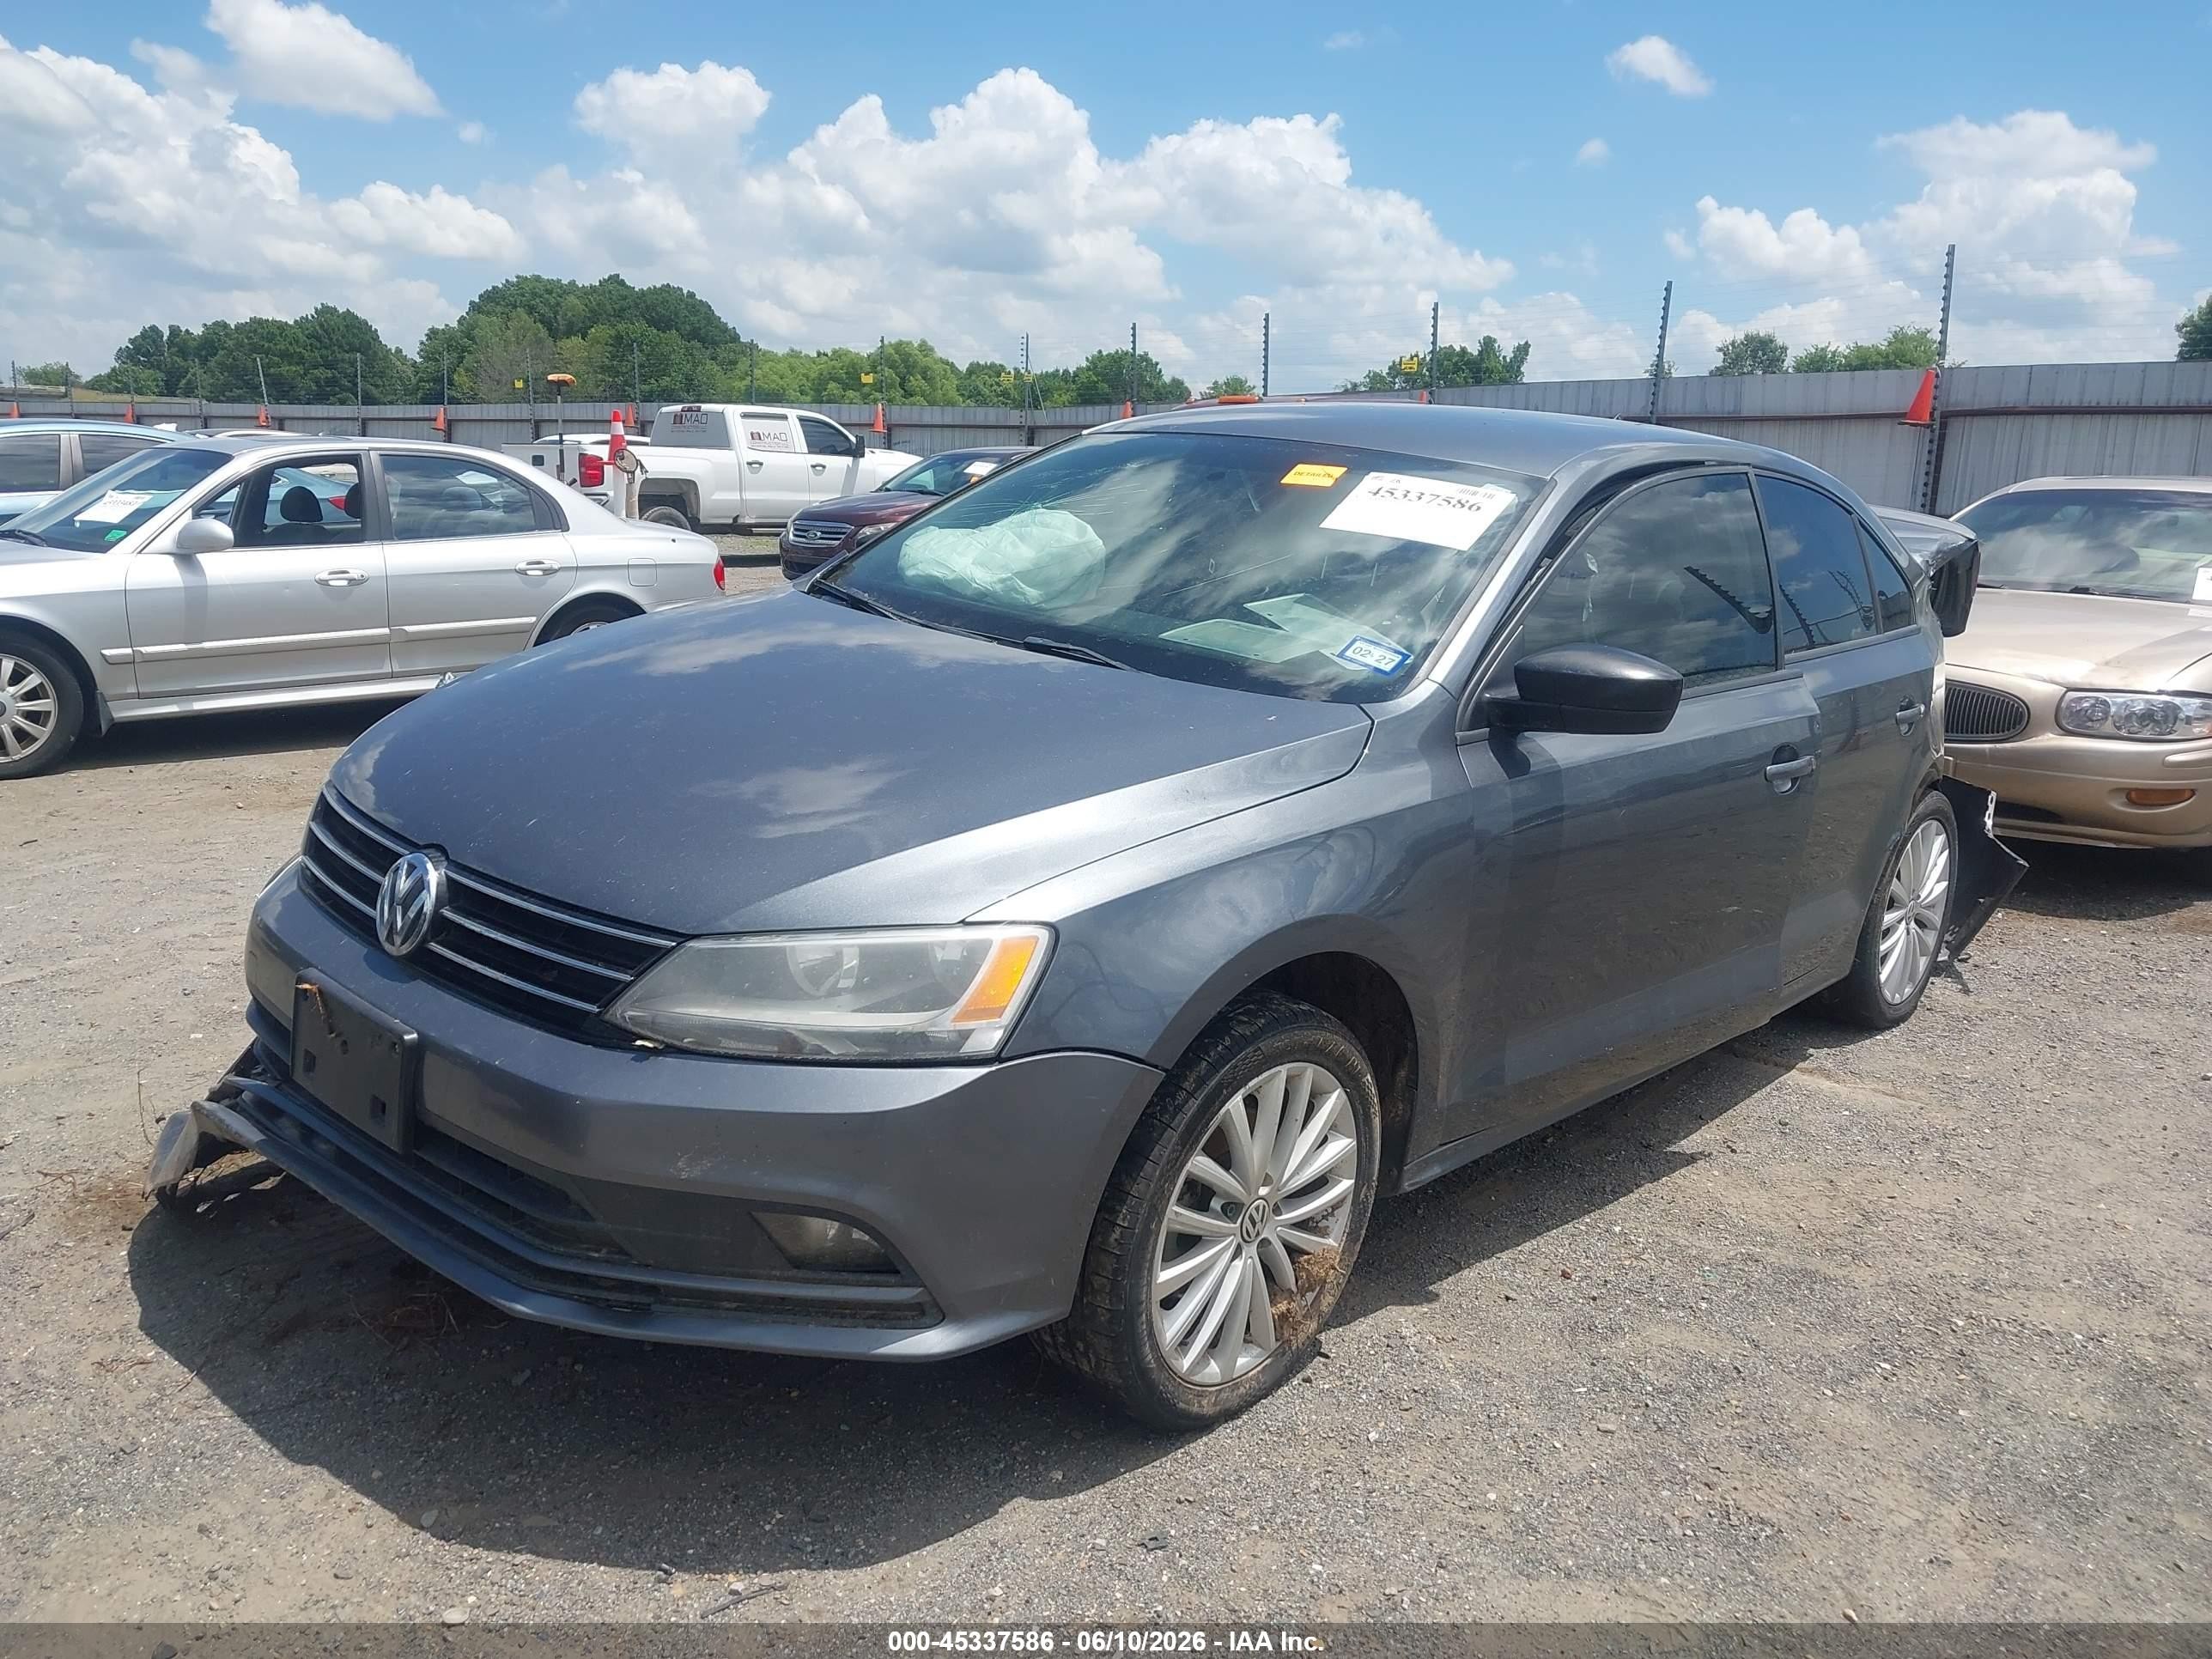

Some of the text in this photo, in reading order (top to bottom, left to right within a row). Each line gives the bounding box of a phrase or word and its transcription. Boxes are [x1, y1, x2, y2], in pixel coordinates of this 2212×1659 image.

[1367, 486, 1484, 513] 45337586
[1352, 647, 1396, 666] 02 27
